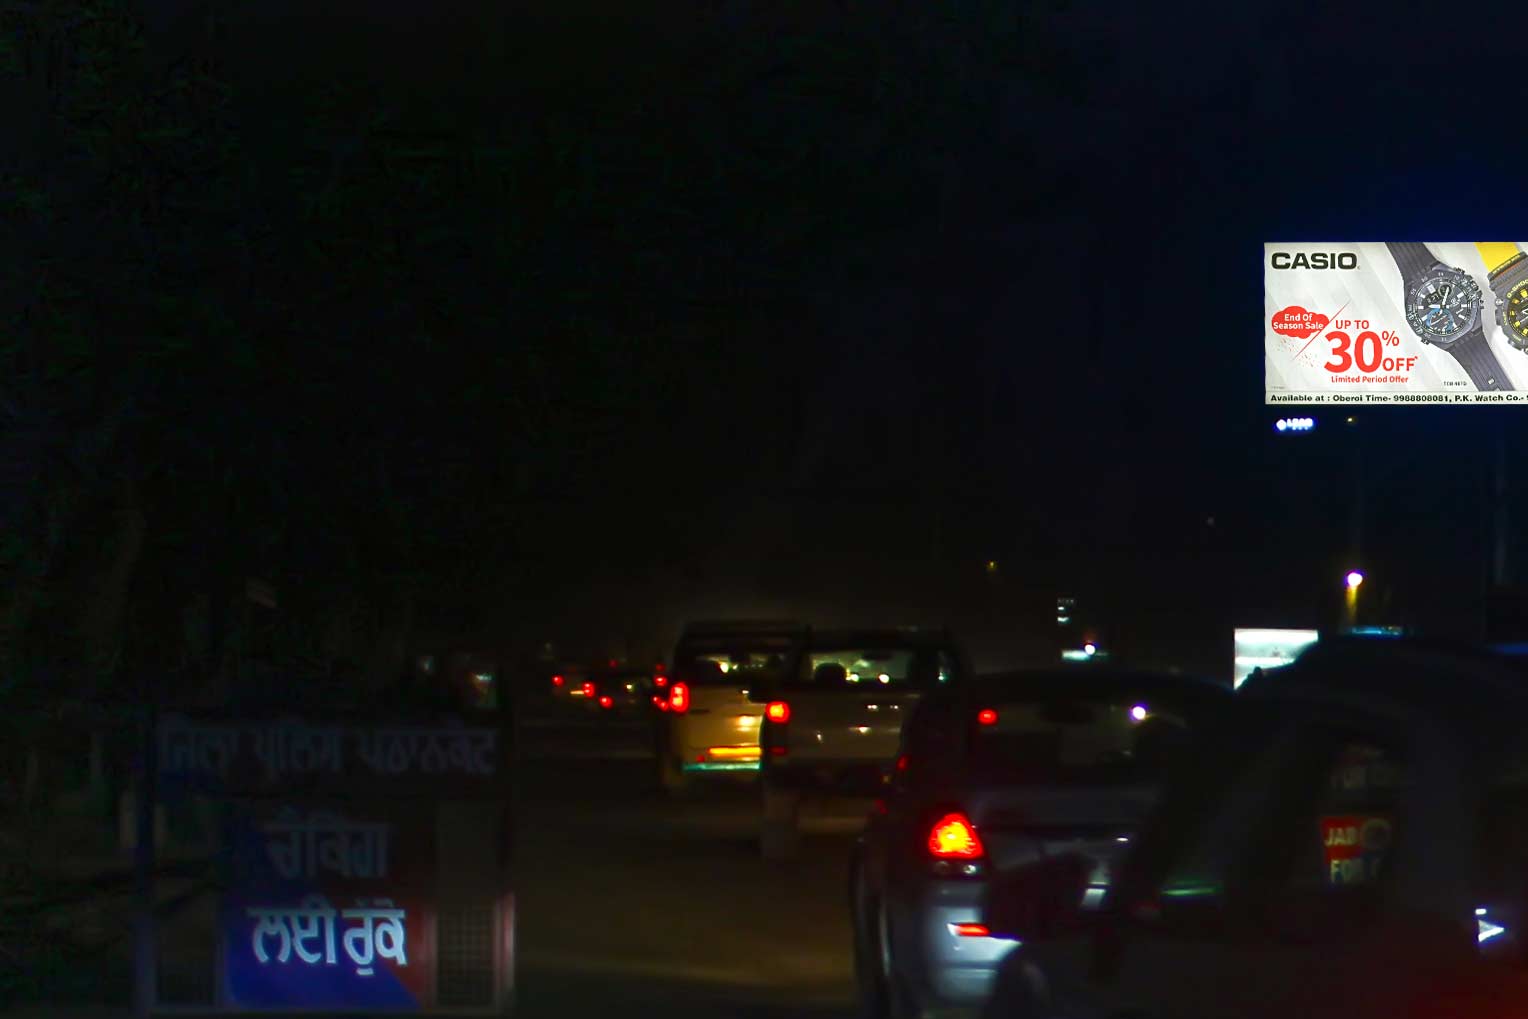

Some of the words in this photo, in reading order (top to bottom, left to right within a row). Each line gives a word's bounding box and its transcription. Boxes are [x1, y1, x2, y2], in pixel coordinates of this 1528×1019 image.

[1271, 252, 1358, 270] CASIO
[1284, 313, 1301, 322] End
[1302, 313, 1313, 322] Of
[1273, 322, 1304, 330] Season
[1305, 322, 1324, 330] Sale
[1335, 319, 1352, 330] UP
[1353, 319, 1370, 330] TO
[1331, 375, 1360, 384] Limited
[1361, 375, 1388, 384] Period
[1389, 375, 1409, 384] Offer
[1270, 394, 1313, 402] Available
[1332, 394, 1363, 402] Oberoi
[1454, 394, 1473, 402] P.K.
[1474, 394, 1503, 402] Watch
